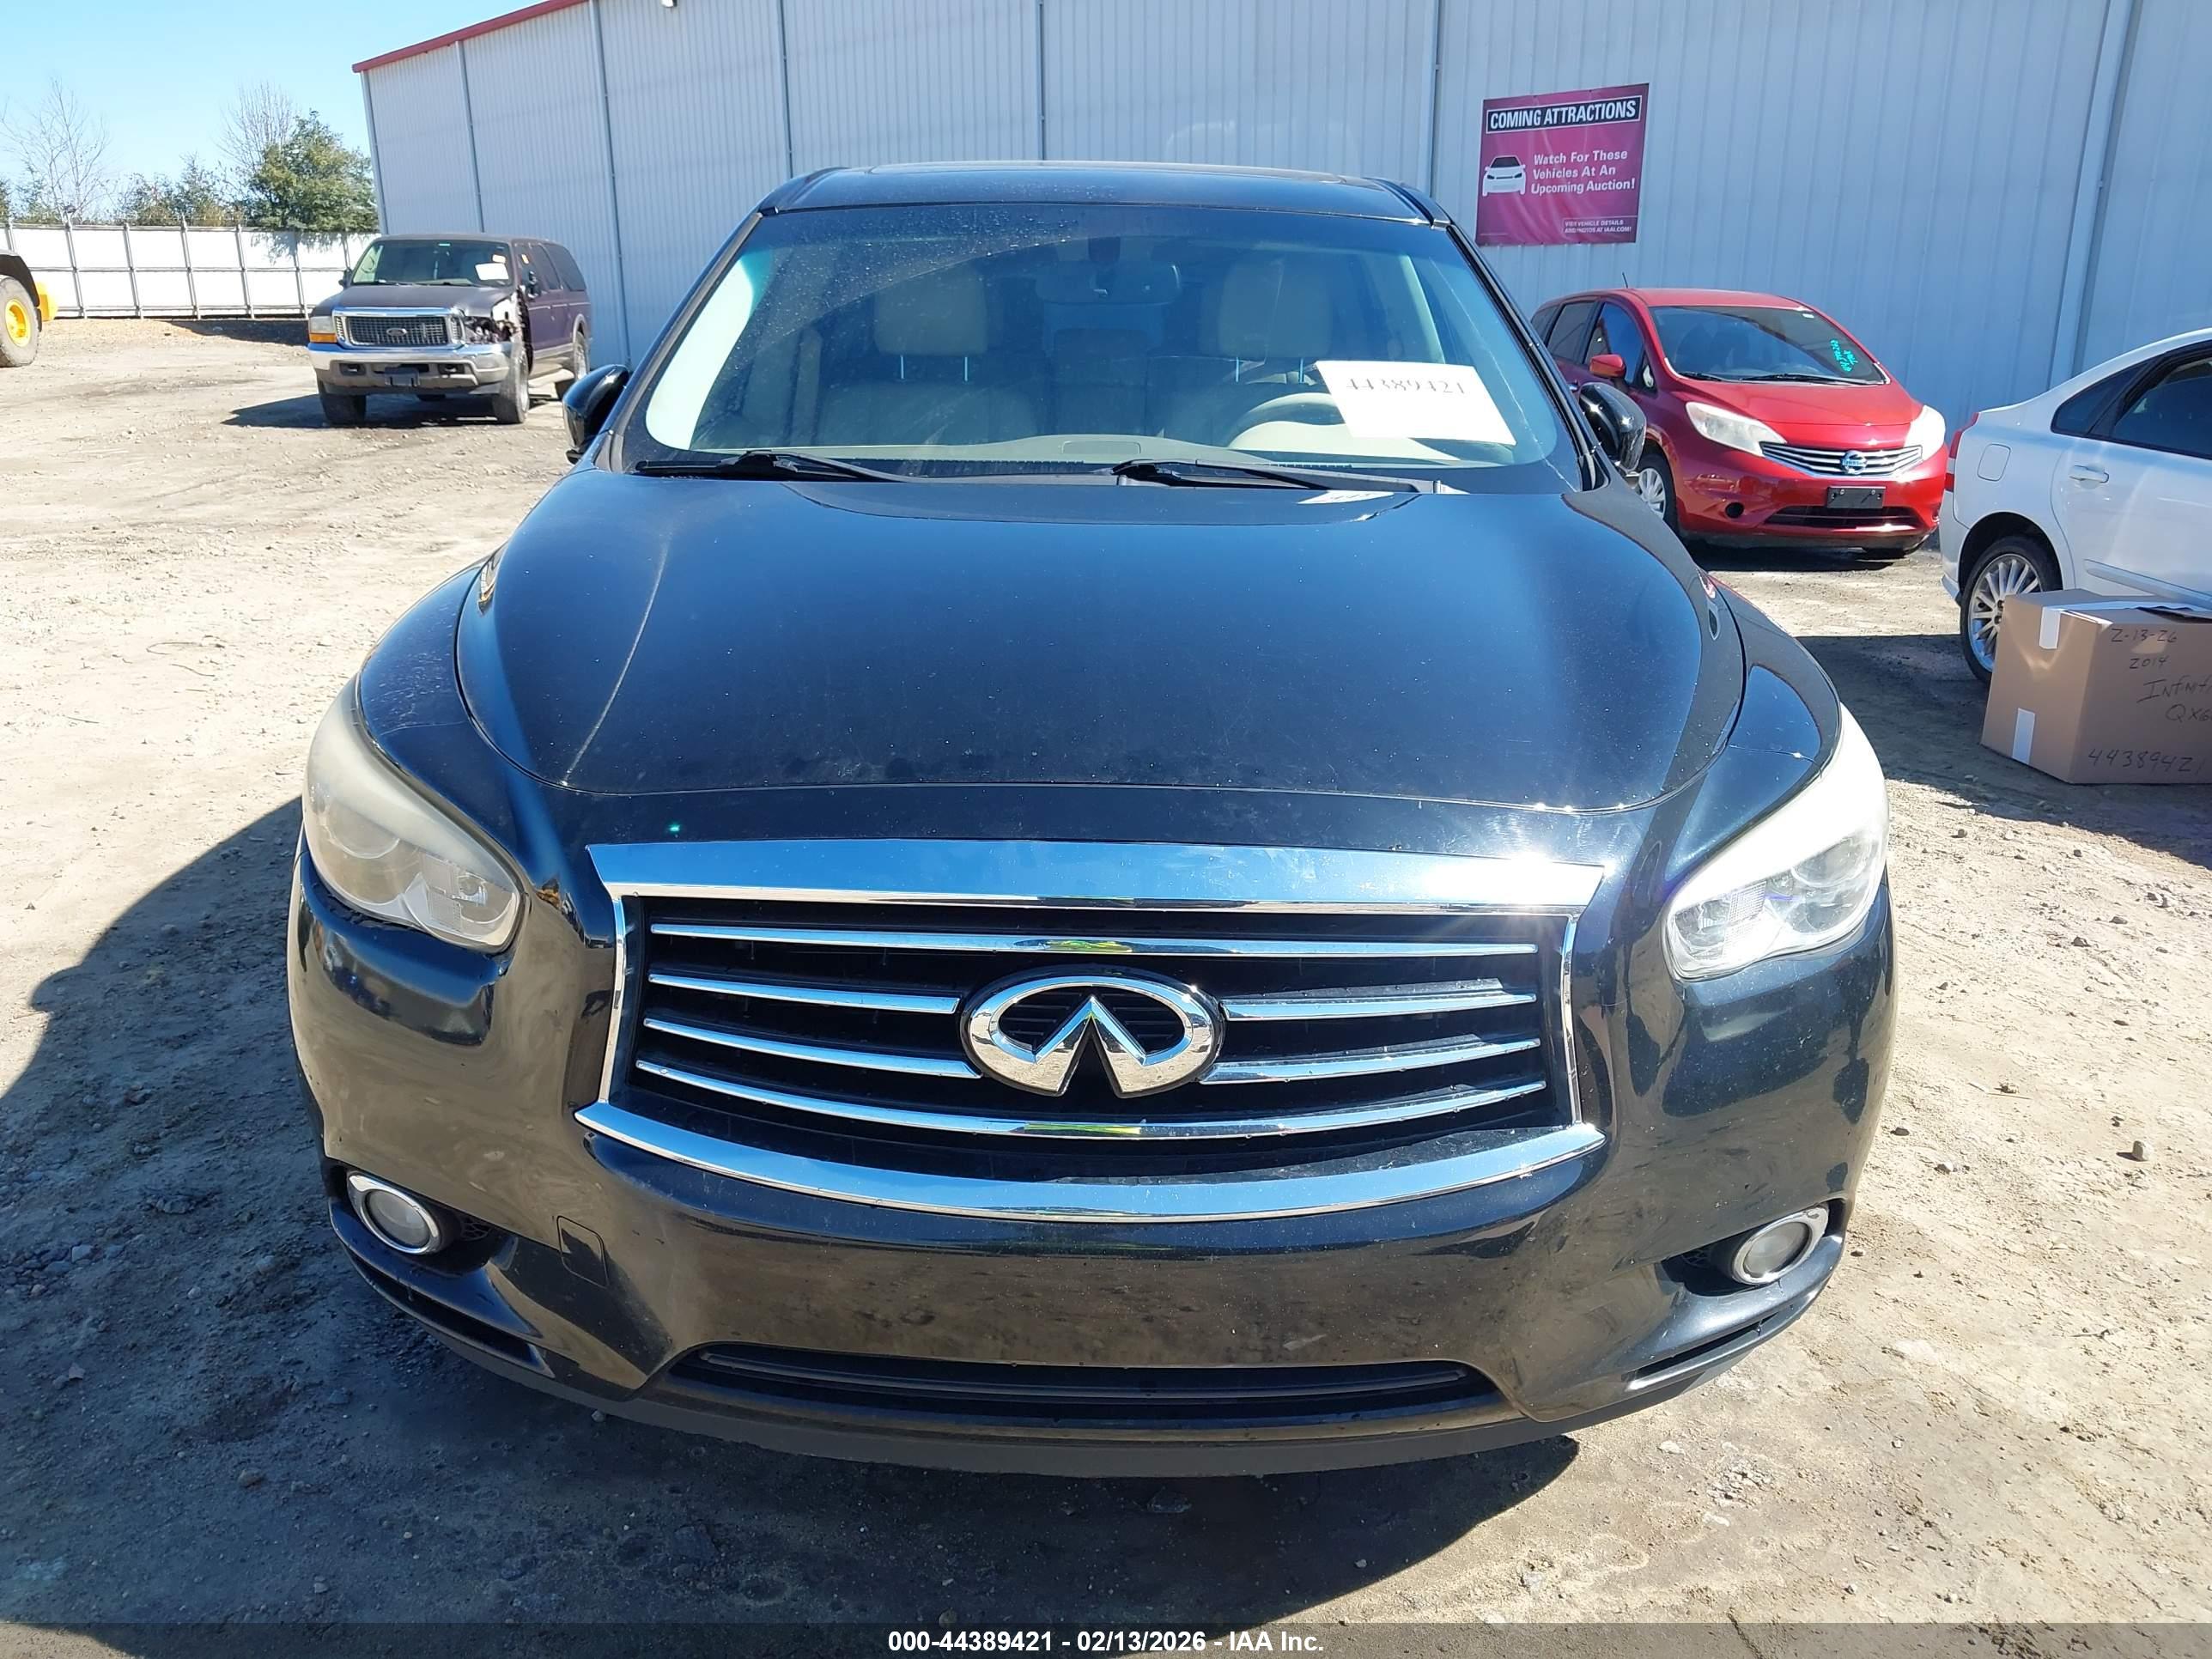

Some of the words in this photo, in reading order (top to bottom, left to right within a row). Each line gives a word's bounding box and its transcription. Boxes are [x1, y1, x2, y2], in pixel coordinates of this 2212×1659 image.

[1490, 110, 1541, 130] COMING
[1544, 100, 1637, 125] ATTRACTIONS
[1534, 153, 1566, 166] Watch
[1571, 152, 1589, 162] For
[1593, 149, 1628, 161] These
[1533, 167, 1578, 179] Vehicles
[1582, 166, 1595, 177] At
[1599, 164, 1616, 176] An
[1531, 181, 1584, 197] Upcoming
[1586, 178, 1636, 191] Auction!
[2087, 748, 2206, 775] 44389421
